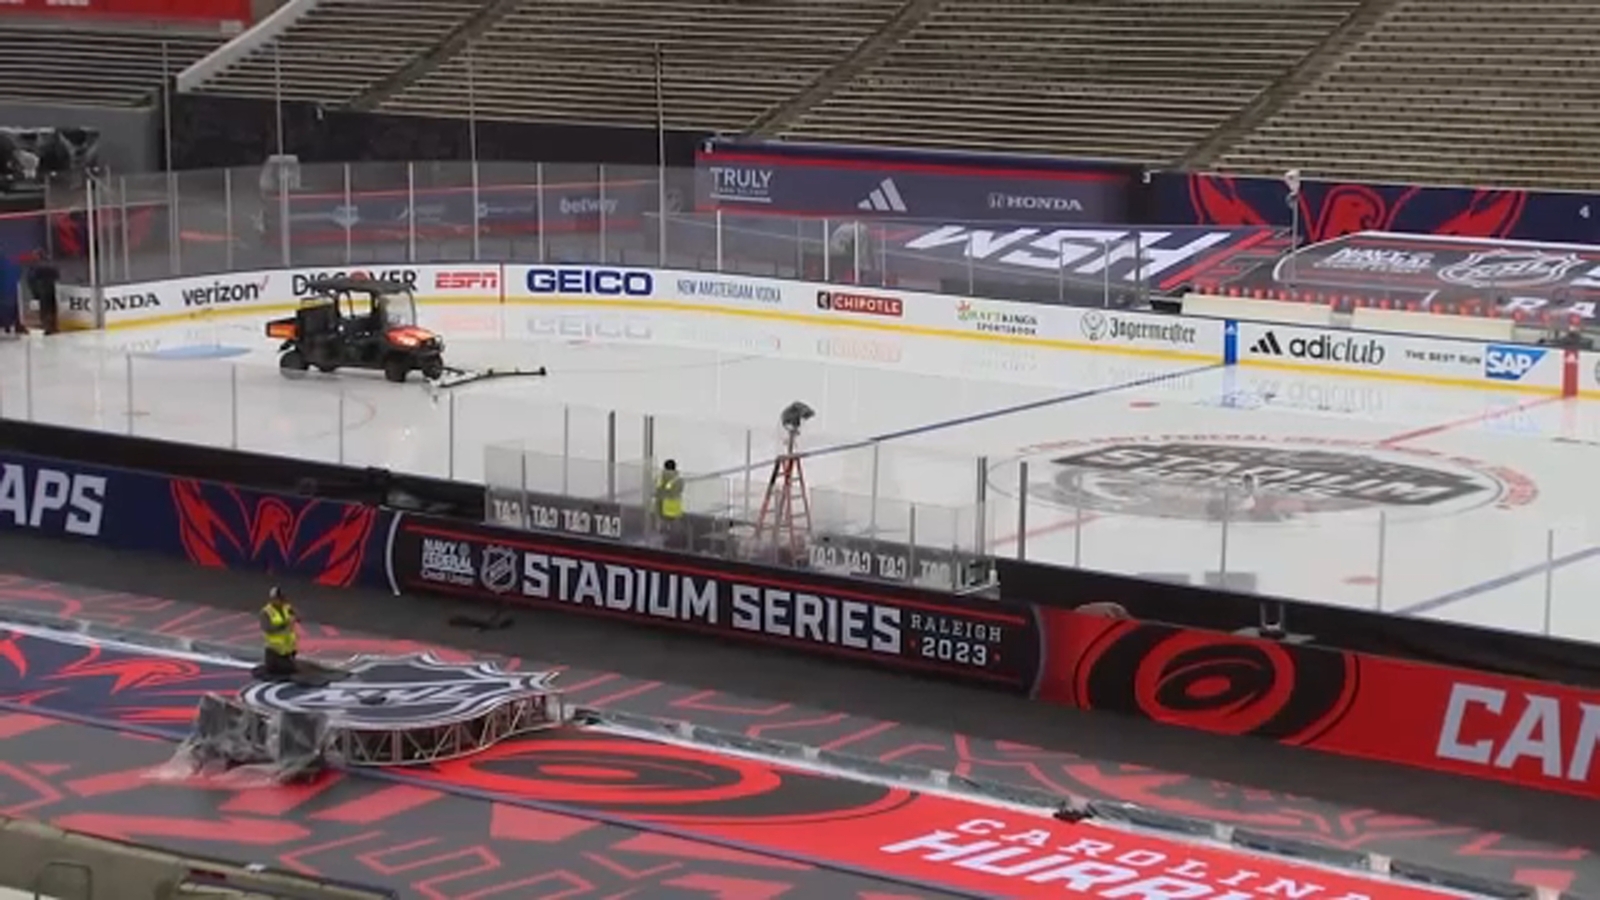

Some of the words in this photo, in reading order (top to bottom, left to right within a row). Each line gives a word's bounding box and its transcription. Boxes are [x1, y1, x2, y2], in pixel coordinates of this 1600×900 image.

[710, 167, 772, 191] TRULY
[560, 197, 617, 214] betway
[1007, 195, 1083, 211] HONDA
[1580, 205, 1589, 218] 4
[435, 272, 498, 289] ESPN
[527, 269, 653, 296] GEICO
[677, 279, 696, 294] NEW
[69, 292, 160, 311] HONDA
[182, 282, 259, 306] verizon
[834, 296, 900, 314] CHIPOTLE
[1289, 335, 1385, 365] adiclub
[1405, 349, 1425, 361] THE
[1429, 351, 1455, 364] BEST
[1459, 353, 1481, 365] RUN
[1486, 349, 1532, 374] SAP
[522, 551, 717, 624] STADIUM
[732, 584, 901, 654] SERIES
[911, 613, 1001, 643] RALEIGH
[922, 636, 987, 666] 2023
